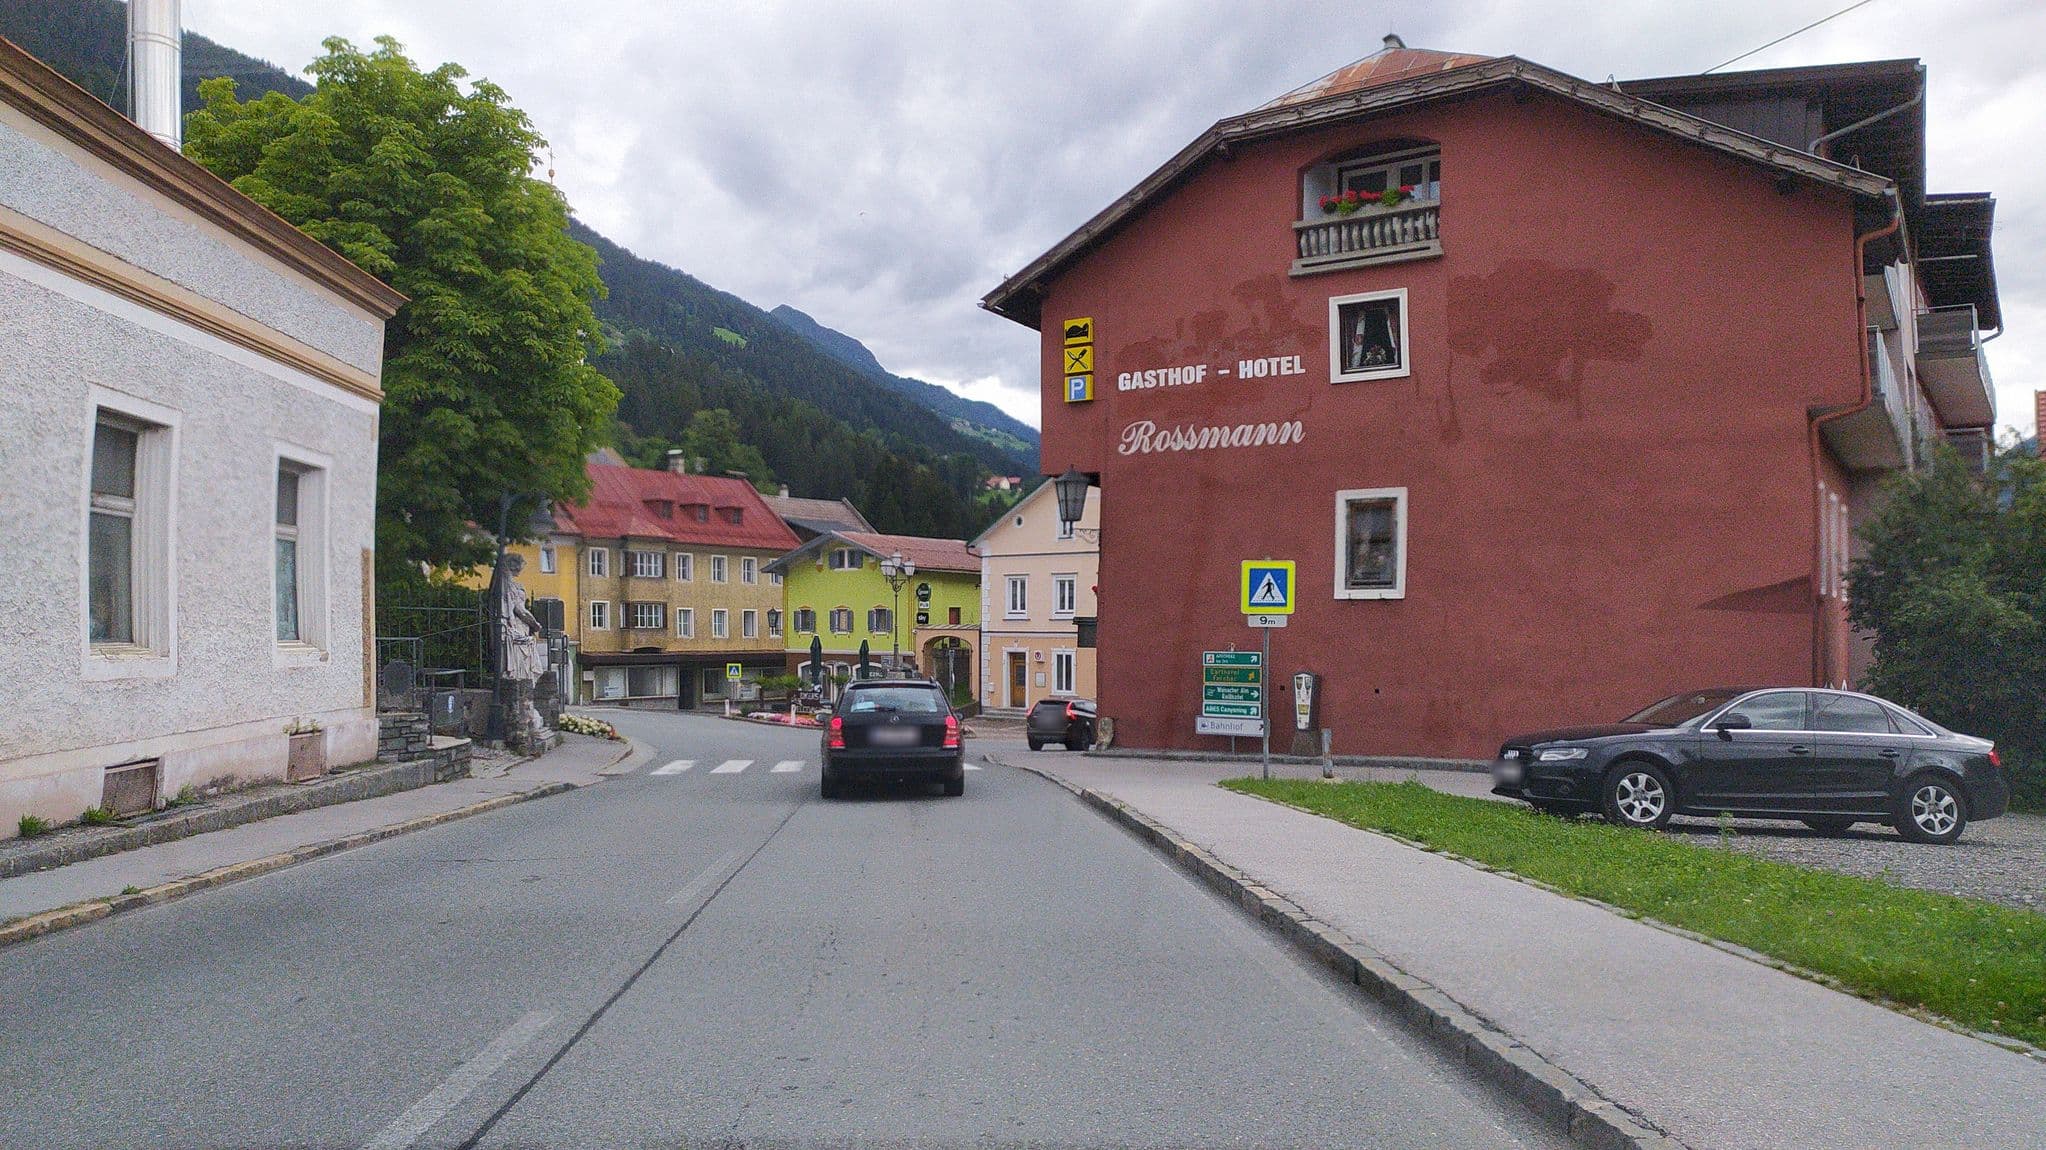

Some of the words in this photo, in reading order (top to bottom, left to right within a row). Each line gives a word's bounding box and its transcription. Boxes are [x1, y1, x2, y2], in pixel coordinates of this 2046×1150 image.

[1117, 364, 1207, 392] GASTHOF
[1238, 355, 1306, 379] HOTEL
[1070, 378, 1085, 399] P
[1118, 420, 1306, 456] Rossmann
[918, 614, 927, 622] sky
[1210, 721, 1243, 731] Bahnhof
